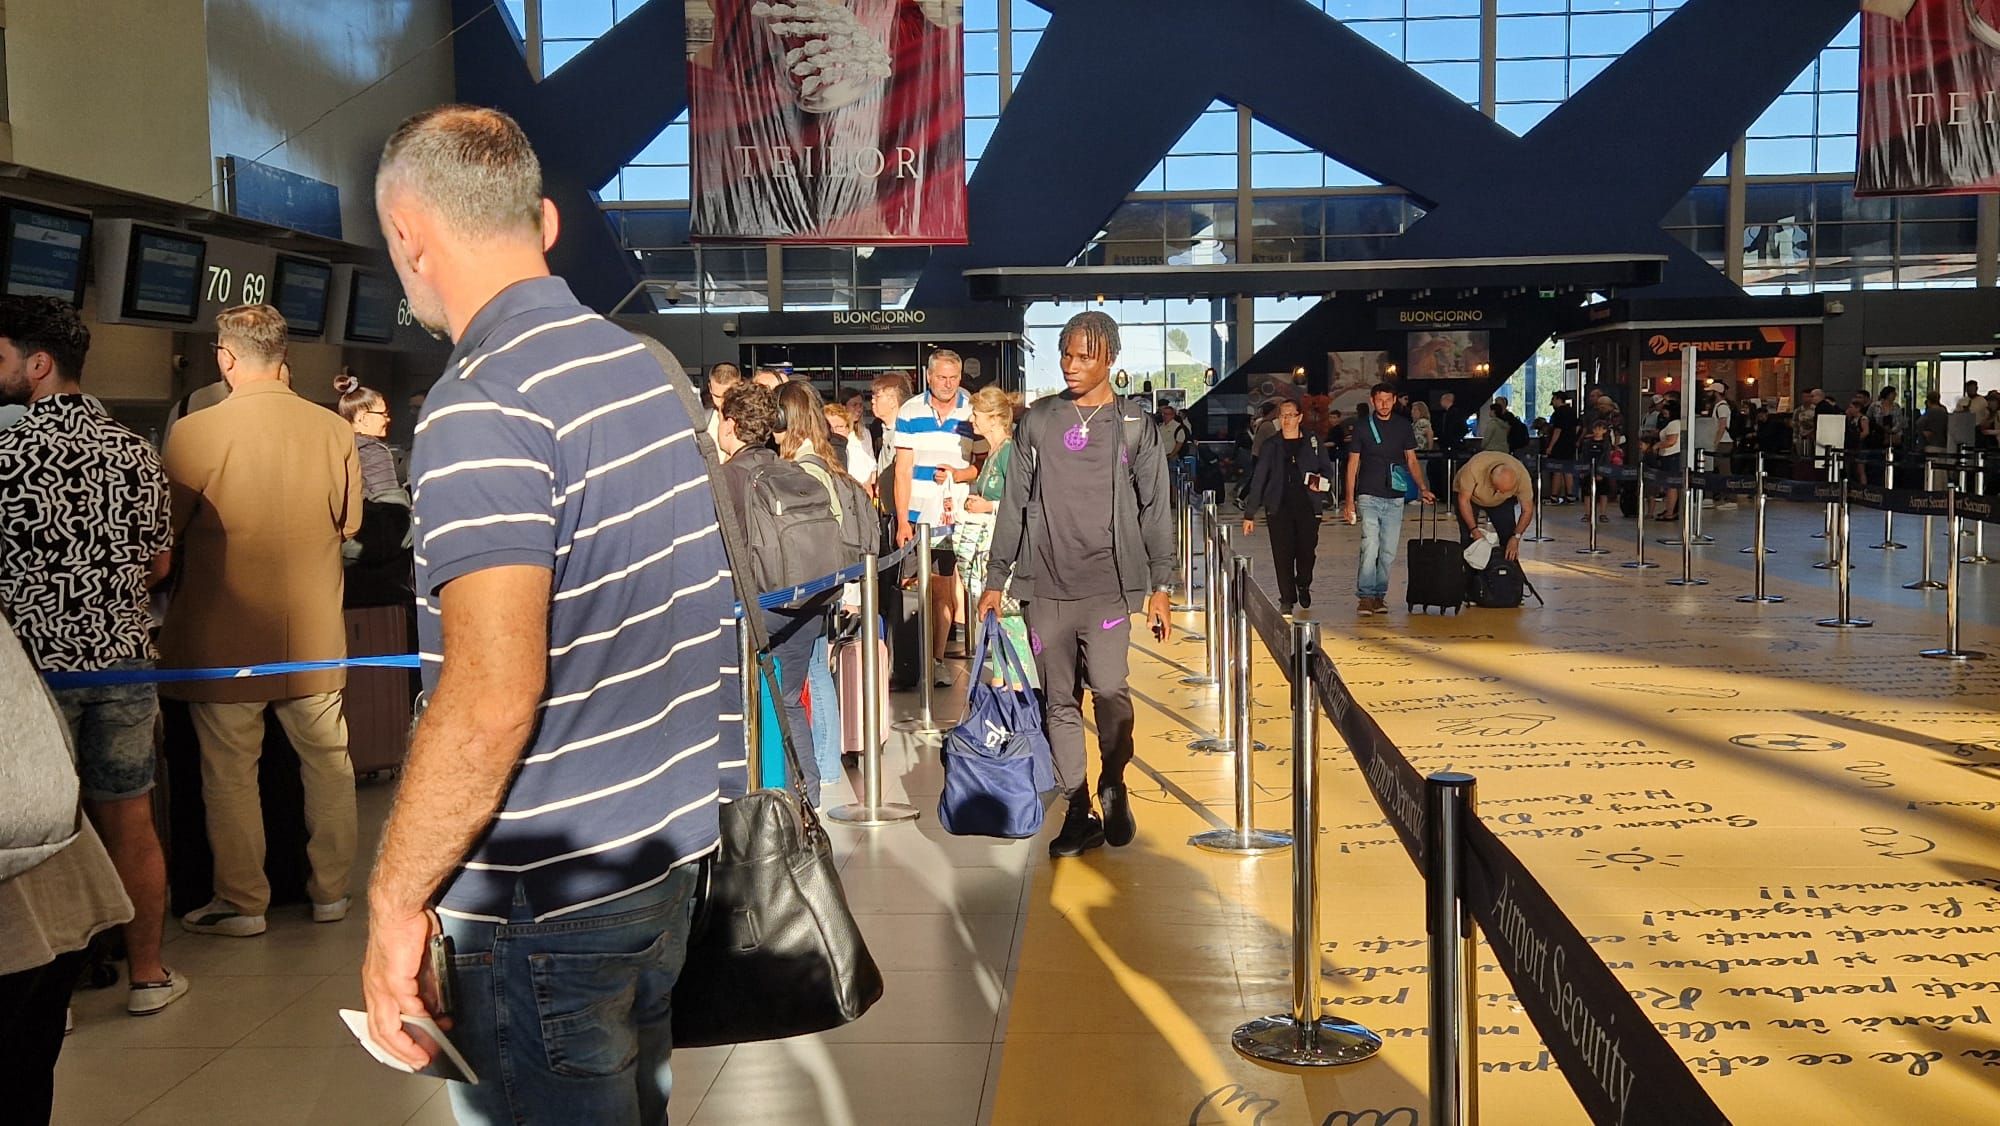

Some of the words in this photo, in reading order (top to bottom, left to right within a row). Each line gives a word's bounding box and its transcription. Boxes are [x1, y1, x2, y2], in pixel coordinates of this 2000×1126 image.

[1906, 90, 2000, 127] TEI
[734, 145, 919, 179] TEILOR
[207, 265, 232, 303] 70
[242, 272, 266, 305] 69
[397, 298, 413, 327] 68
[833, 310, 926, 324] BUONGIORNO
[1400, 310, 1483, 322] BUONGIORNO
[1668, 340, 1753, 352] FORNETTI
[1601, 788, 1677, 800] Hai
[1540, 809, 1585, 818] cu
[1612, 814, 1758, 830] Suntem
[1493, 824, 1603, 839] alătur
[1641, 902, 1909, 928] câștigători!
[1919, 896, 1964, 920] fi
[1639, 930, 1681, 948] și
[1696, 927, 1812, 948] uniți
[1825, 925, 2000, 945] mâneți
[1648, 949, 1820, 975] pentru
[1832, 951, 1877, 970] și
[1491, 872, 1548, 993] Airport
[1550, 944, 1636, 1126] Security
[1718, 975, 1898, 1004] pentru
[1766, 1018, 1831, 1035] în
[1841, 1005, 1992, 1032] până
[1685, 1048, 1770, 1078] ați
[1786, 1052, 1853, 1068] ce
[1867, 1050, 1944, 1077] de
